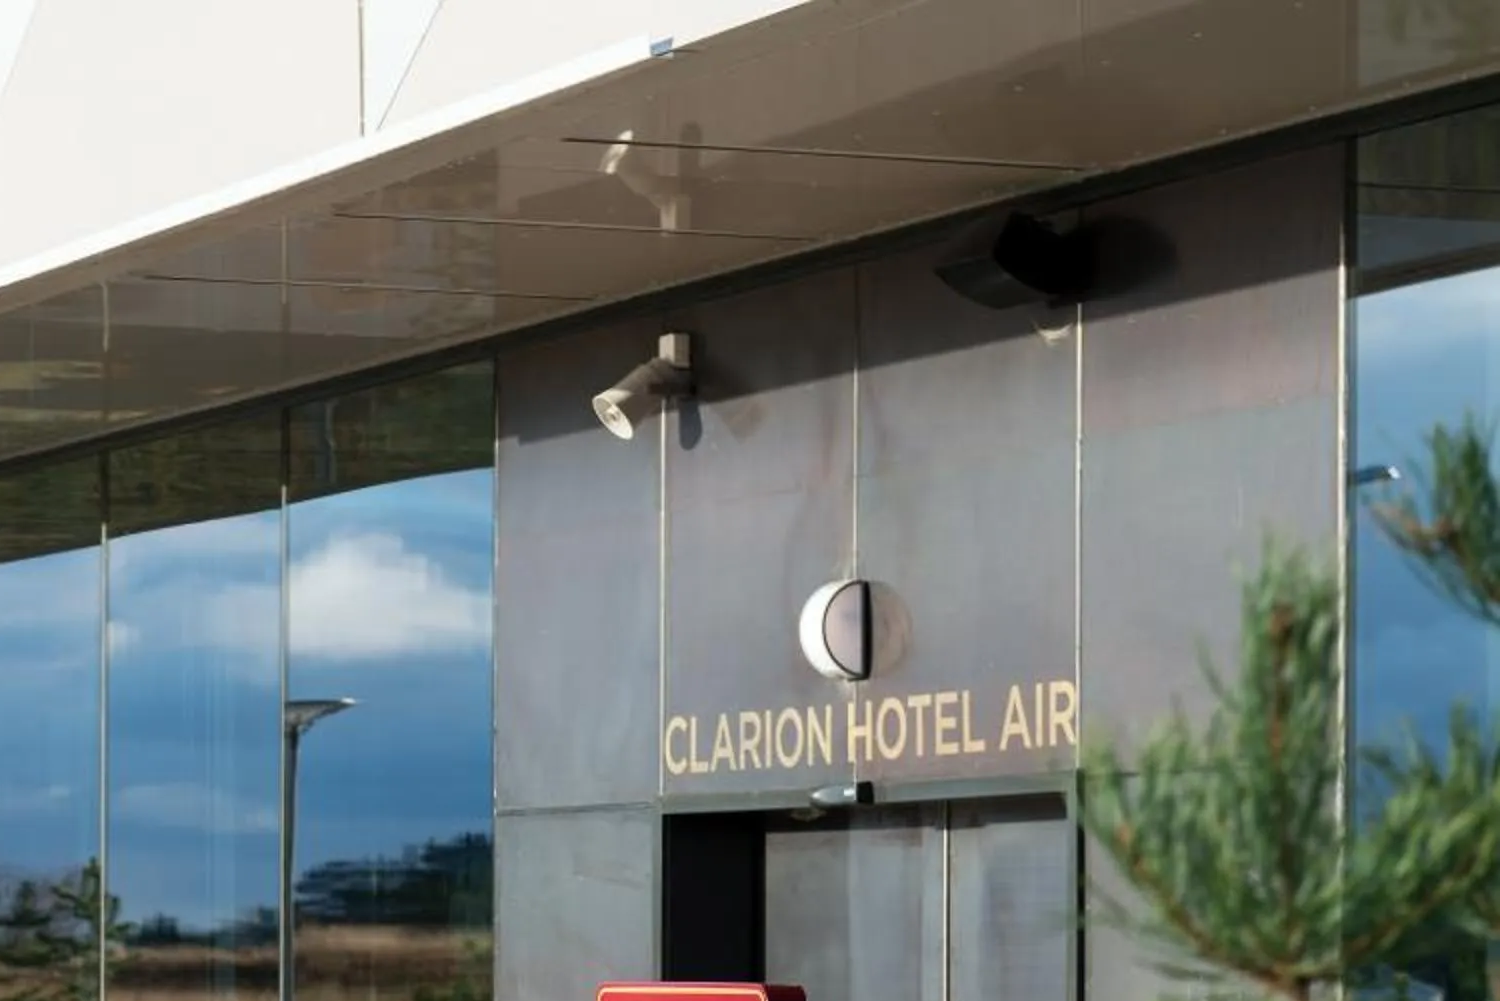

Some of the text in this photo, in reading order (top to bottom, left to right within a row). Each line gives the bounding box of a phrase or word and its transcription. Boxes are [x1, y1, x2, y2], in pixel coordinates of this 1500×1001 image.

[665, 680, 1077, 775] CLARION HOTEL AIR
